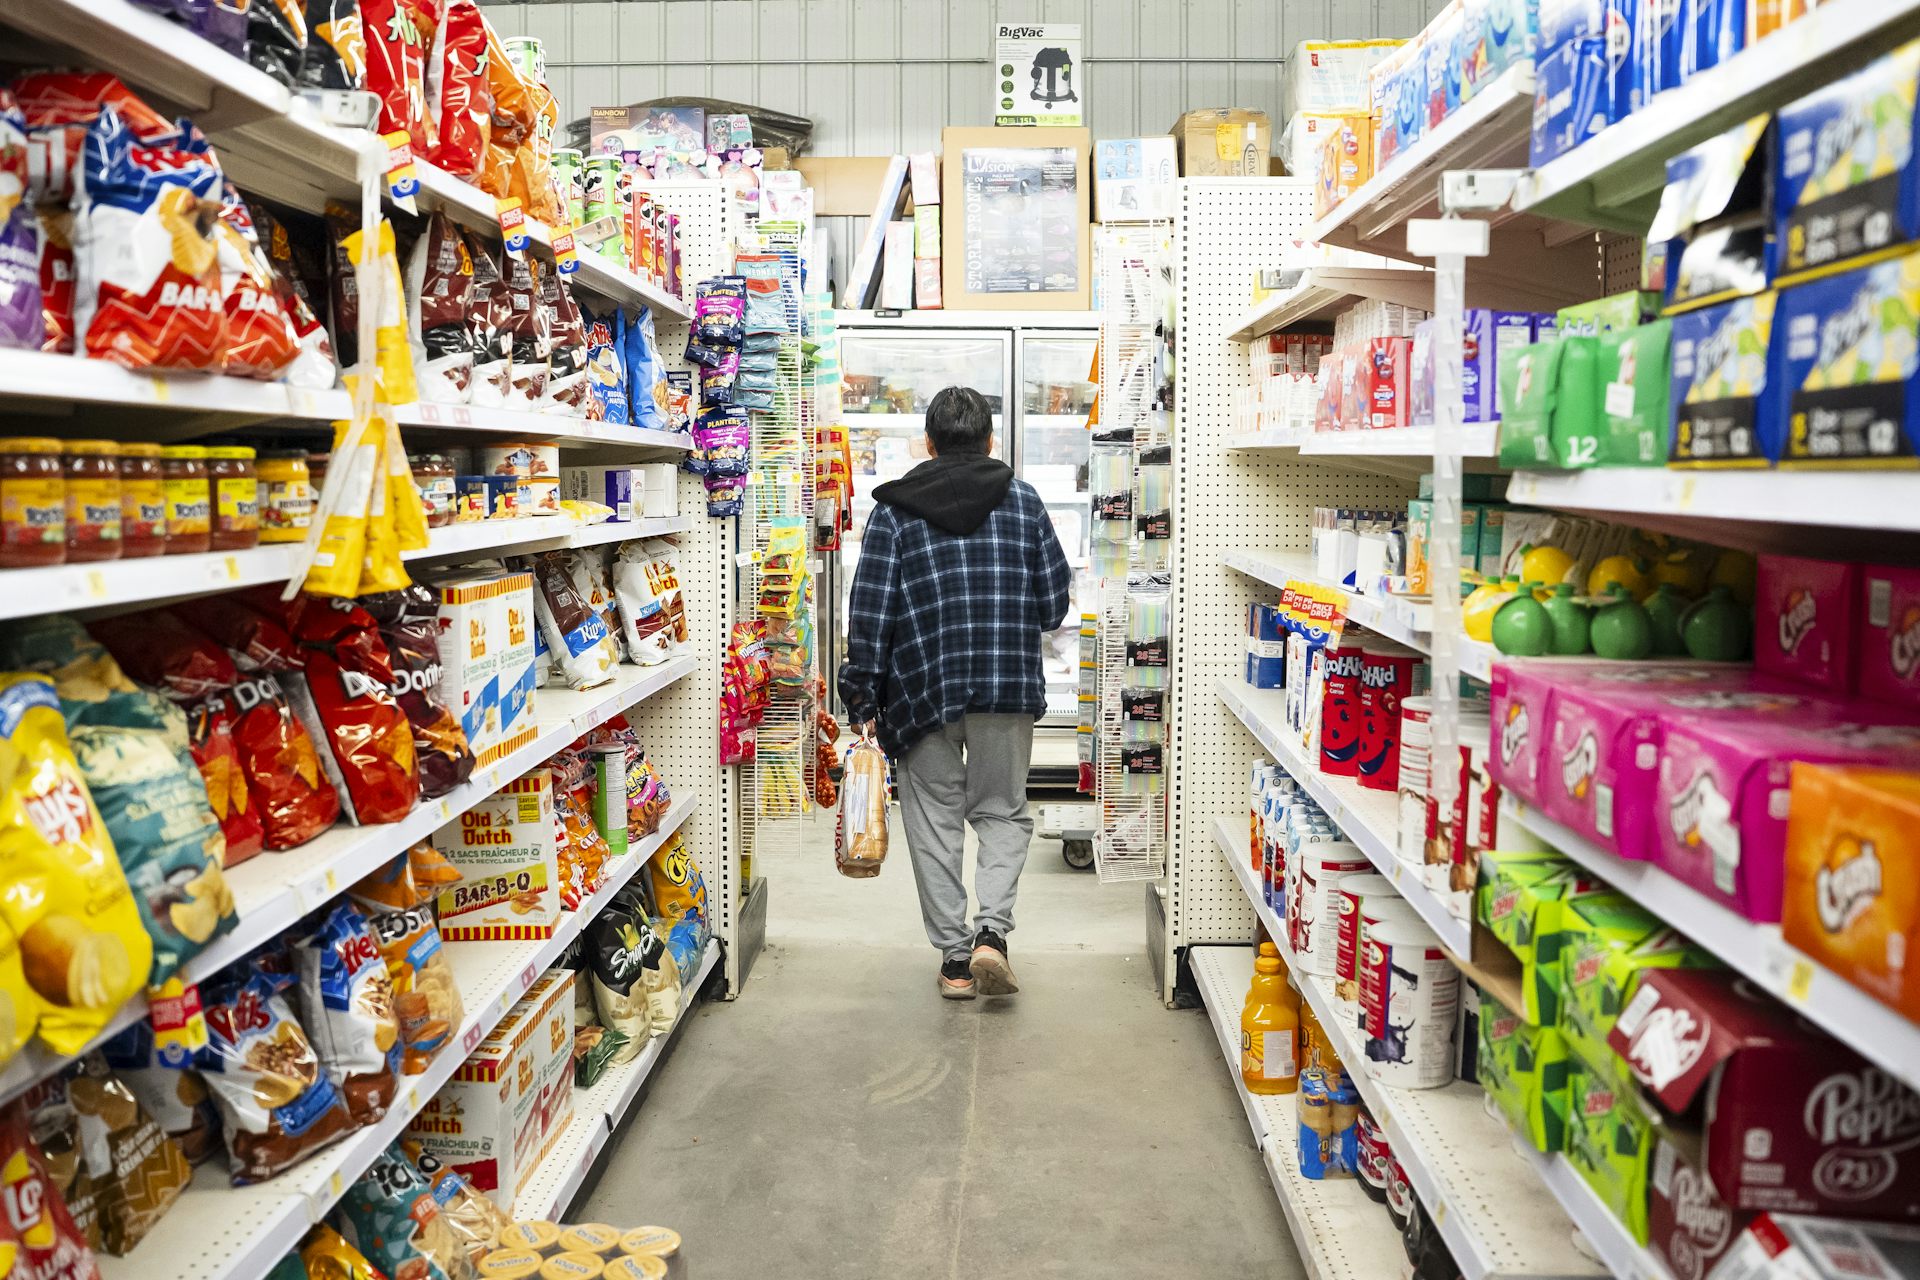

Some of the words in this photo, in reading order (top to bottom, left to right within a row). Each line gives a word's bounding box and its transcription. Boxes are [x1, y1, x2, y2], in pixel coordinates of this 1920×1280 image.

[999, 26, 1044, 39] BigVac
[704, 289, 738, 297] PLANTERS
[707, 419, 741, 428] PLANTERS
[1567, 435, 1599, 465] 12
[1284, 589, 1296, 598] PRI
[1312, 603, 1334, 612] PRICE
[1310, 610, 1333, 619] DROP
[1362, 664, 1396, 688] ol-Aid
[461, 811, 492, 828] Old
[463, 828, 513, 846] Dutch
[457, 850, 479, 858] SACS
[481, 847, 529, 858] FRAÎCHEUR
[455, 872, 531, 908] BAR-B-Q
[424, 1097, 441, 1113] ld
[426, 1136, 480, 1149] FRAÎCHEUR
[428, 1149, 476, 1157] CYCLABLES
[1833, 1159, 1870, 1189] 23
